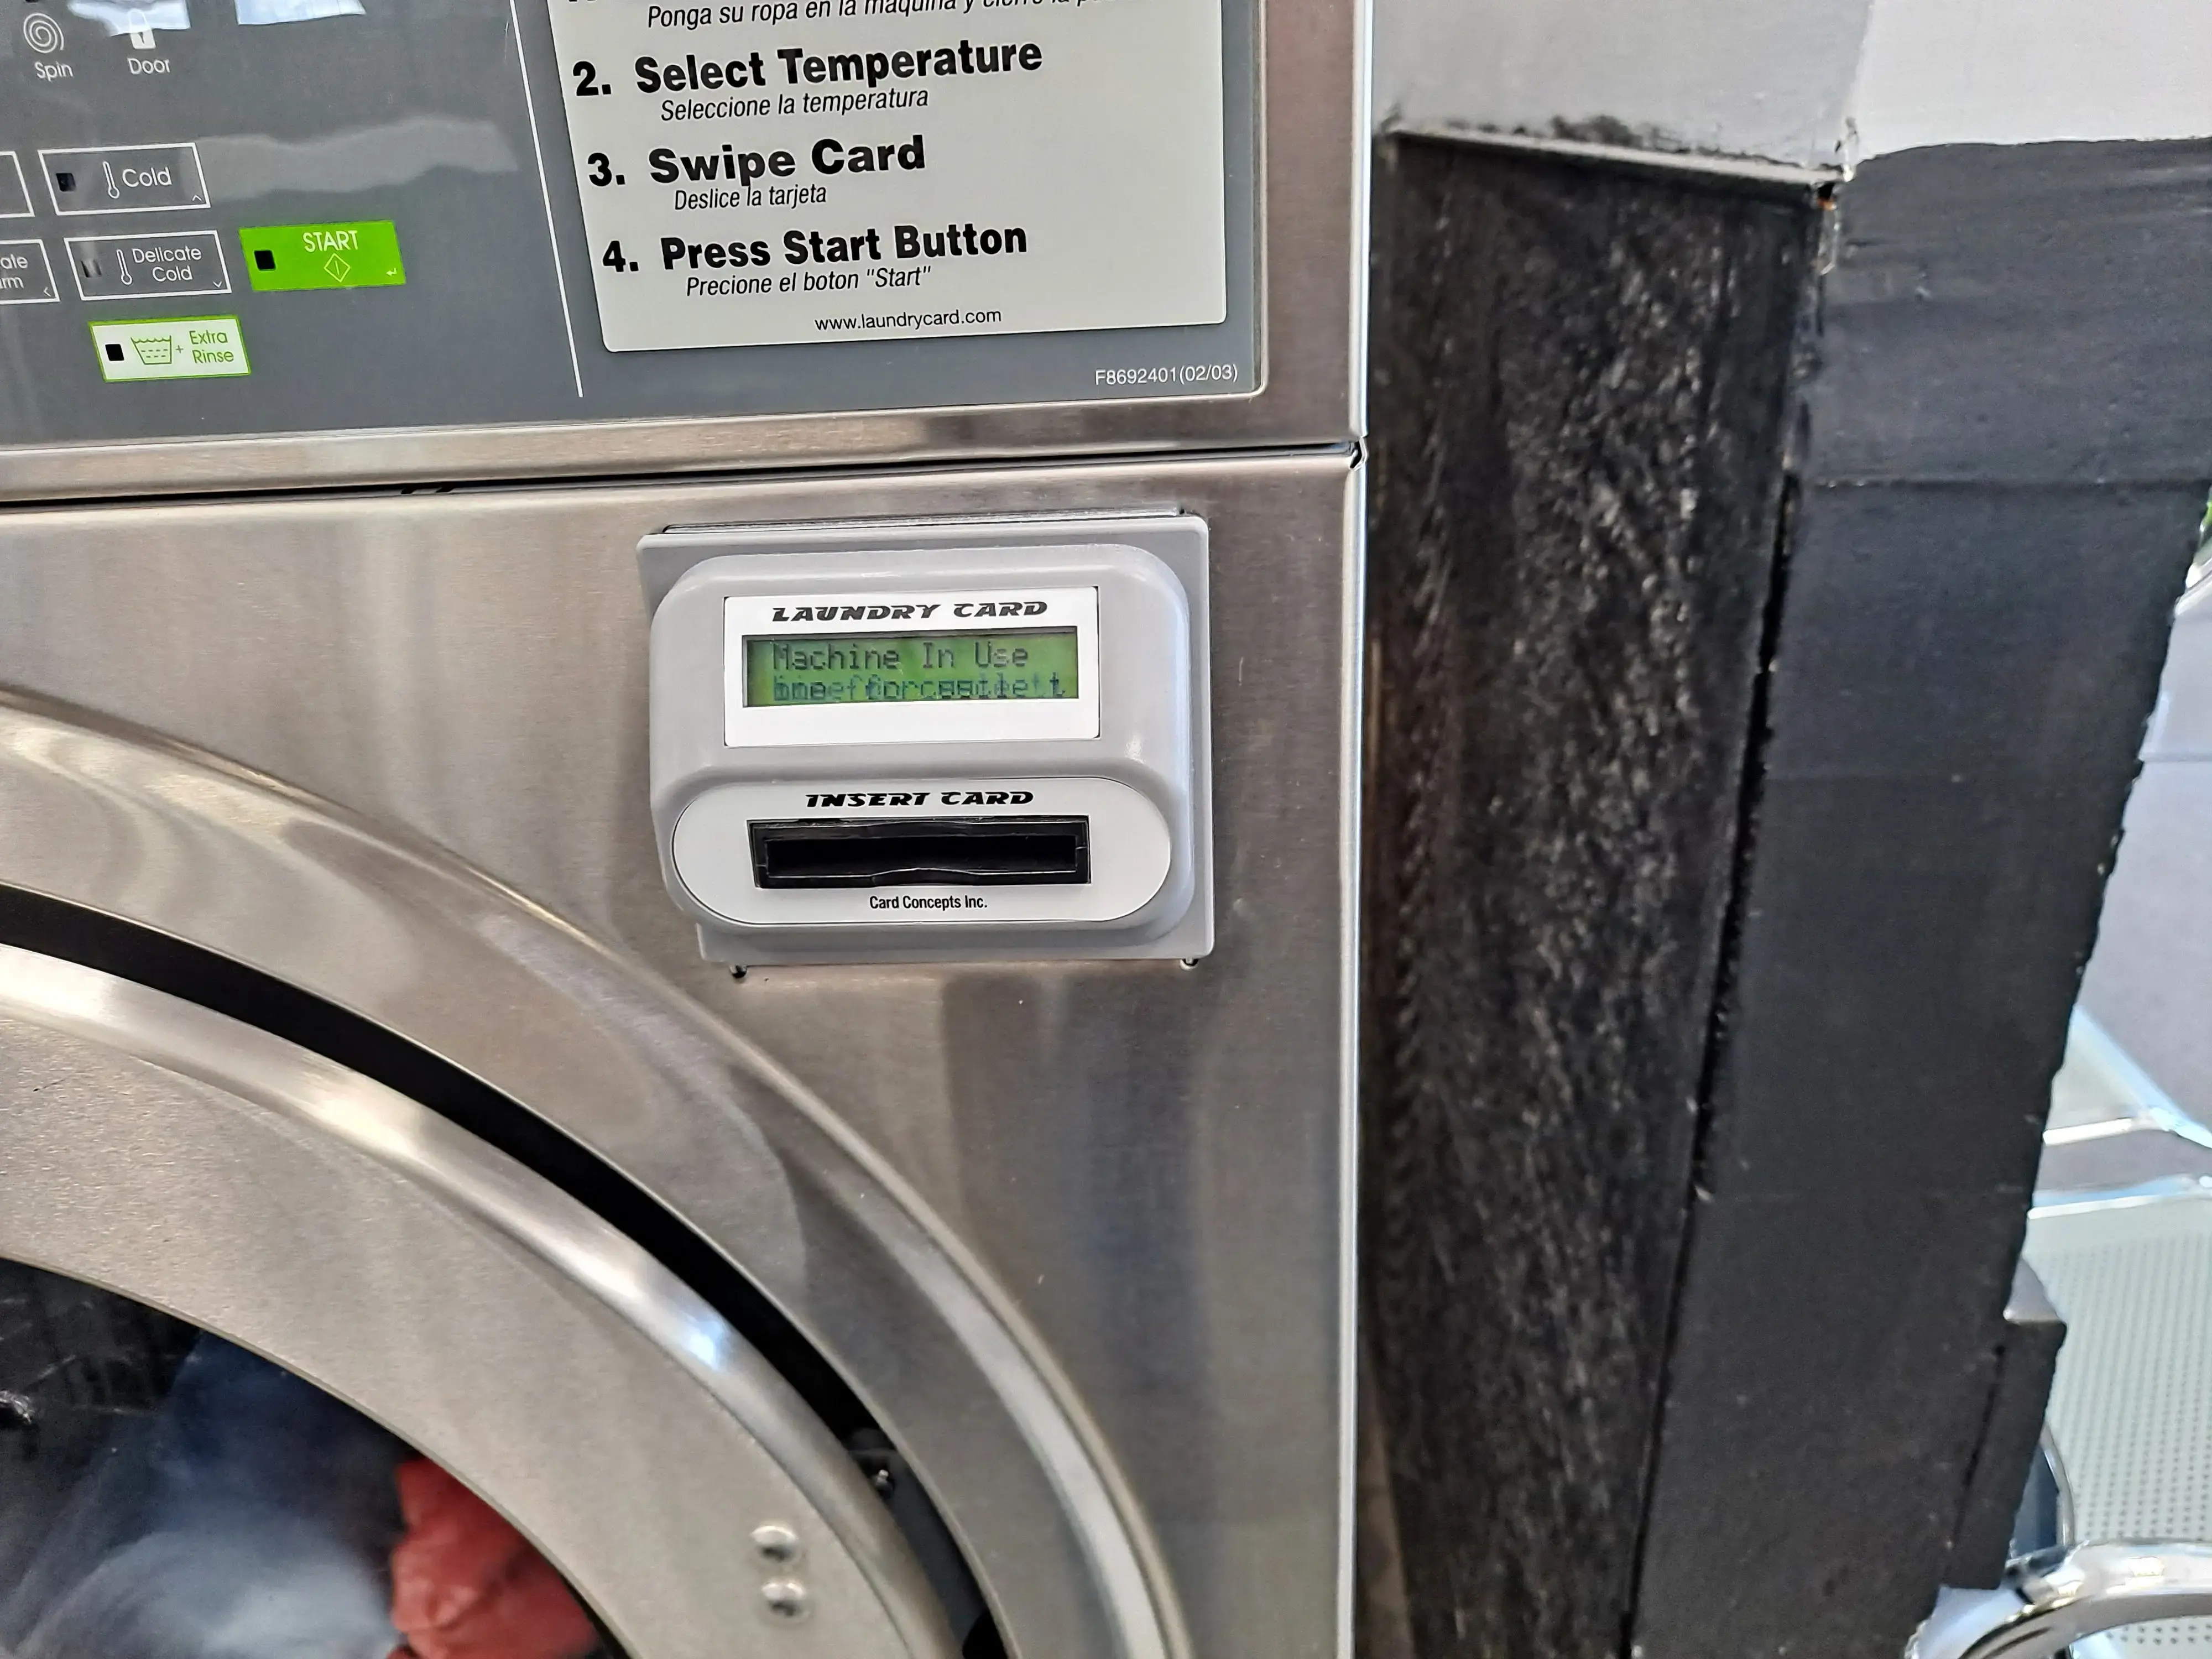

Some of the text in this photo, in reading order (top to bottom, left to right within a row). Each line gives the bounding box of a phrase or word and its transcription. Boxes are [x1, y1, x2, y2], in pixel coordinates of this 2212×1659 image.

[649, 6, 711, 30] Ponga
[719, 6, 743, 23] su
[752, 3, 797, 25] ropa
[806, 1, 830, 18] en
[839, 0, 855, 16] la
[35, 61, 74, 82] Spin
[127, 57, 170, 75] Door
[573, 40, 1042, 96] 2. Select Temperature
[661, 88, 927, 121] Seleccione la temperatura
[588, 135, 925, 186] 3. Swipe Card
[122, 166, 172, 187] Cold
[675, 184, 826, 210] Deslice la tarjeta
[302, 230, 358, 252] START
[603, 223, 1026, 272] 4. Press Start Button
[132, 246, 202, 262] Delicate
[152, 265, 193, 282] Cold
[687, 266, 930, 296] Precione el boton "Start"
[815, 310, 1001, 330] www.laundrycard.com
[189, 330, 228, 345] Extra
[192, 349, 234, 363] Rinse
[1095, 364, 1238, 385] F8692401(02/03)
[772, 601, 1047, 621] LAUNDRY CARD
[774, 641, 1028, 670] Machine In Use
[806, 791, 1033, 807] INSERT CARD
[870, 895, 987, 911] Card Concepts Inc.
